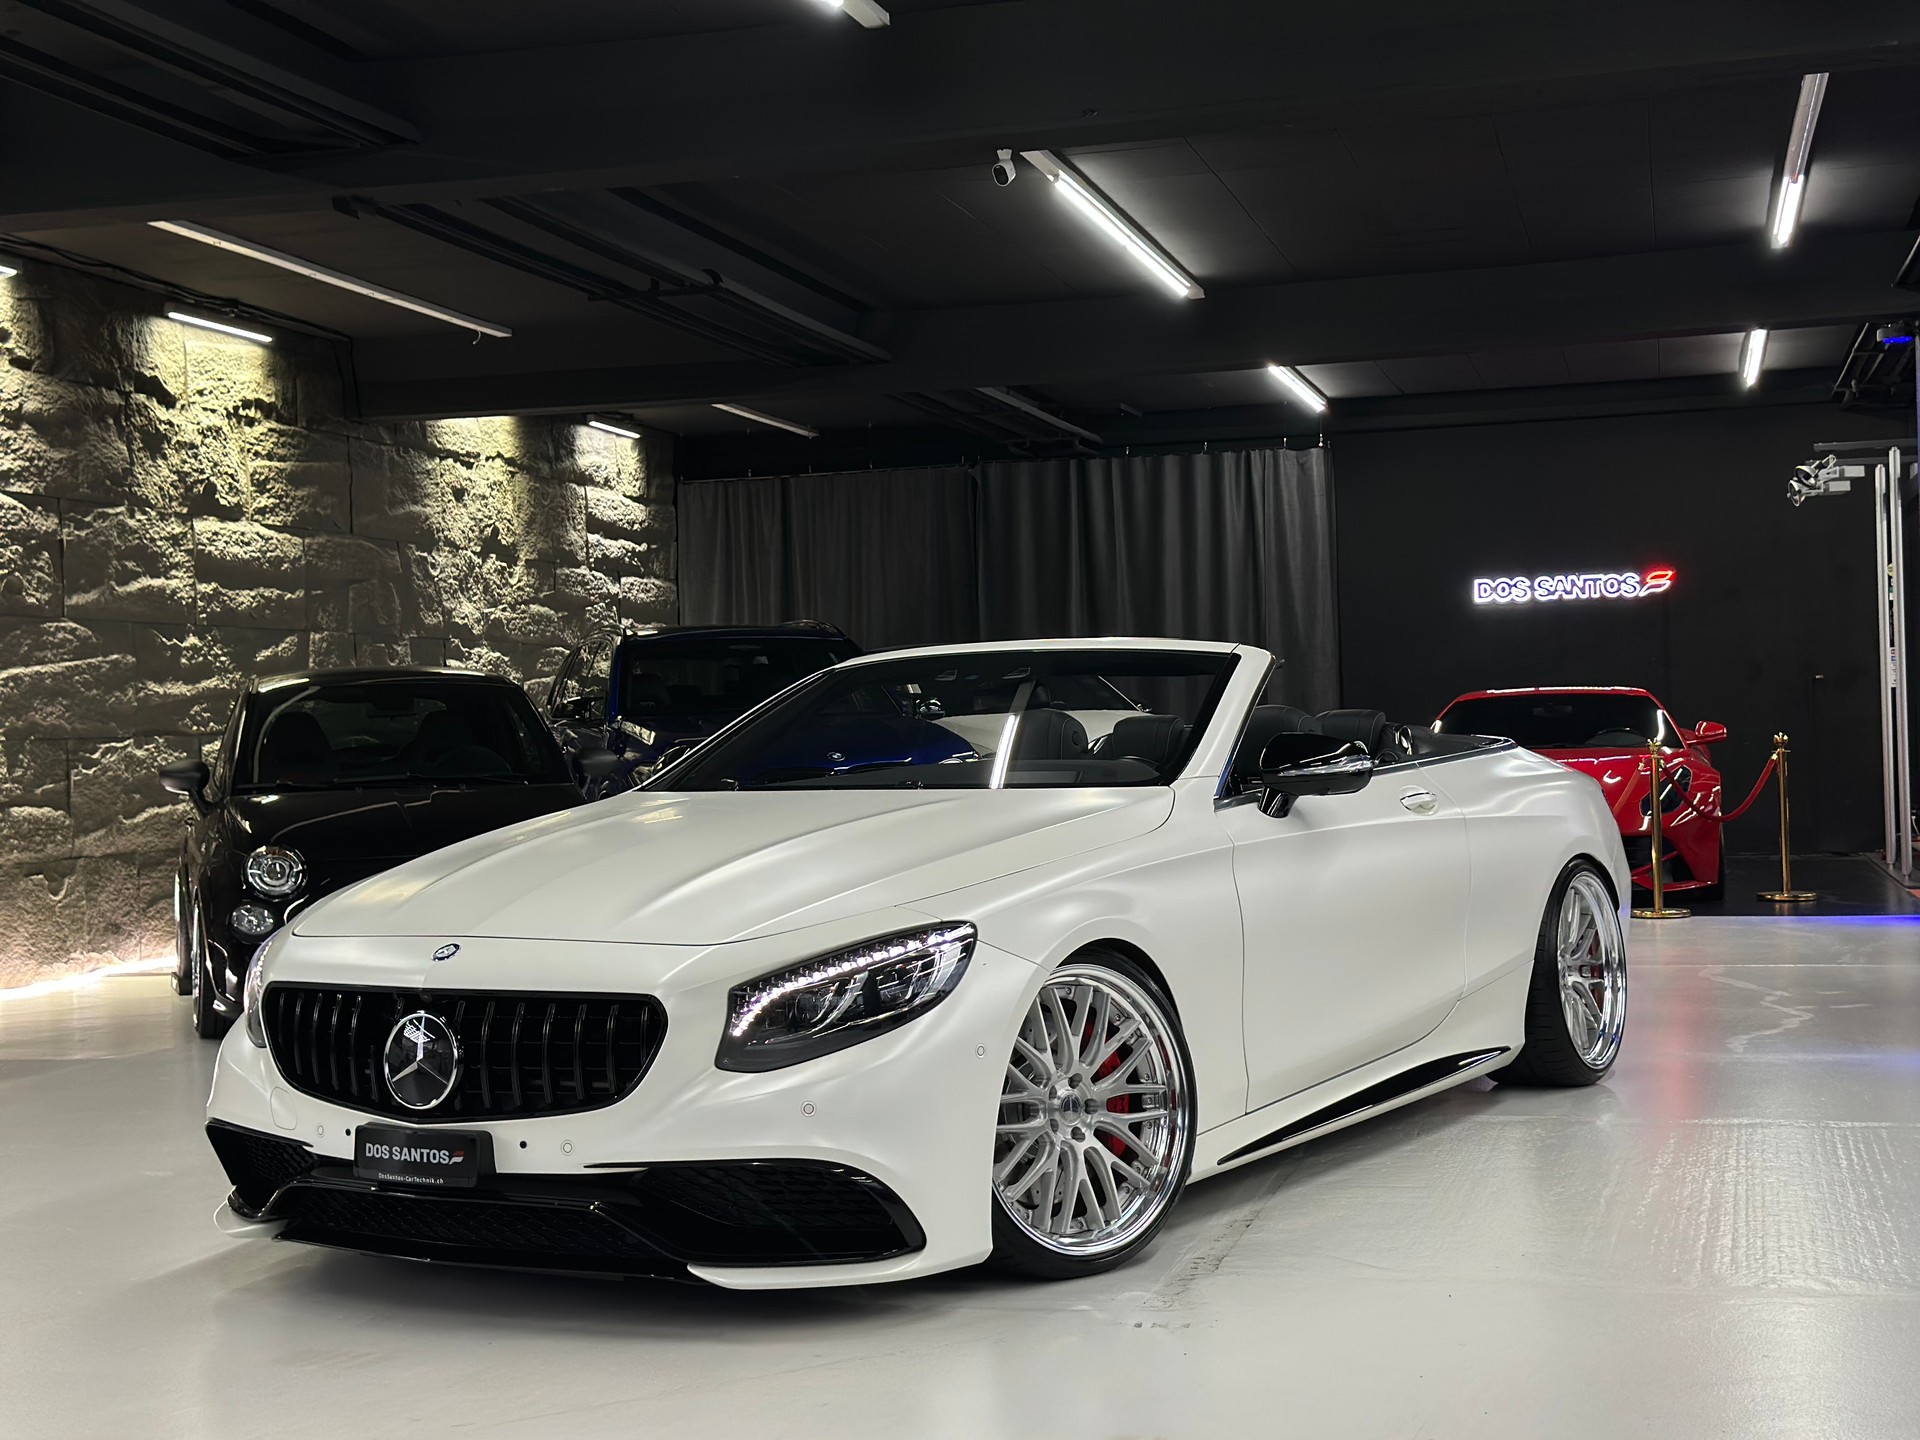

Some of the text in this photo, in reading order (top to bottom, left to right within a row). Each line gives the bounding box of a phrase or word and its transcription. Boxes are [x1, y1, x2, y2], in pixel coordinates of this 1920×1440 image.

[1474, 573, 1640, 603] DOS SANTOS
[365, 1142, 450, 1164] DOS SANTOS
[378, 1172, 444, 1184] DosSantos-CarTechnik.ch
